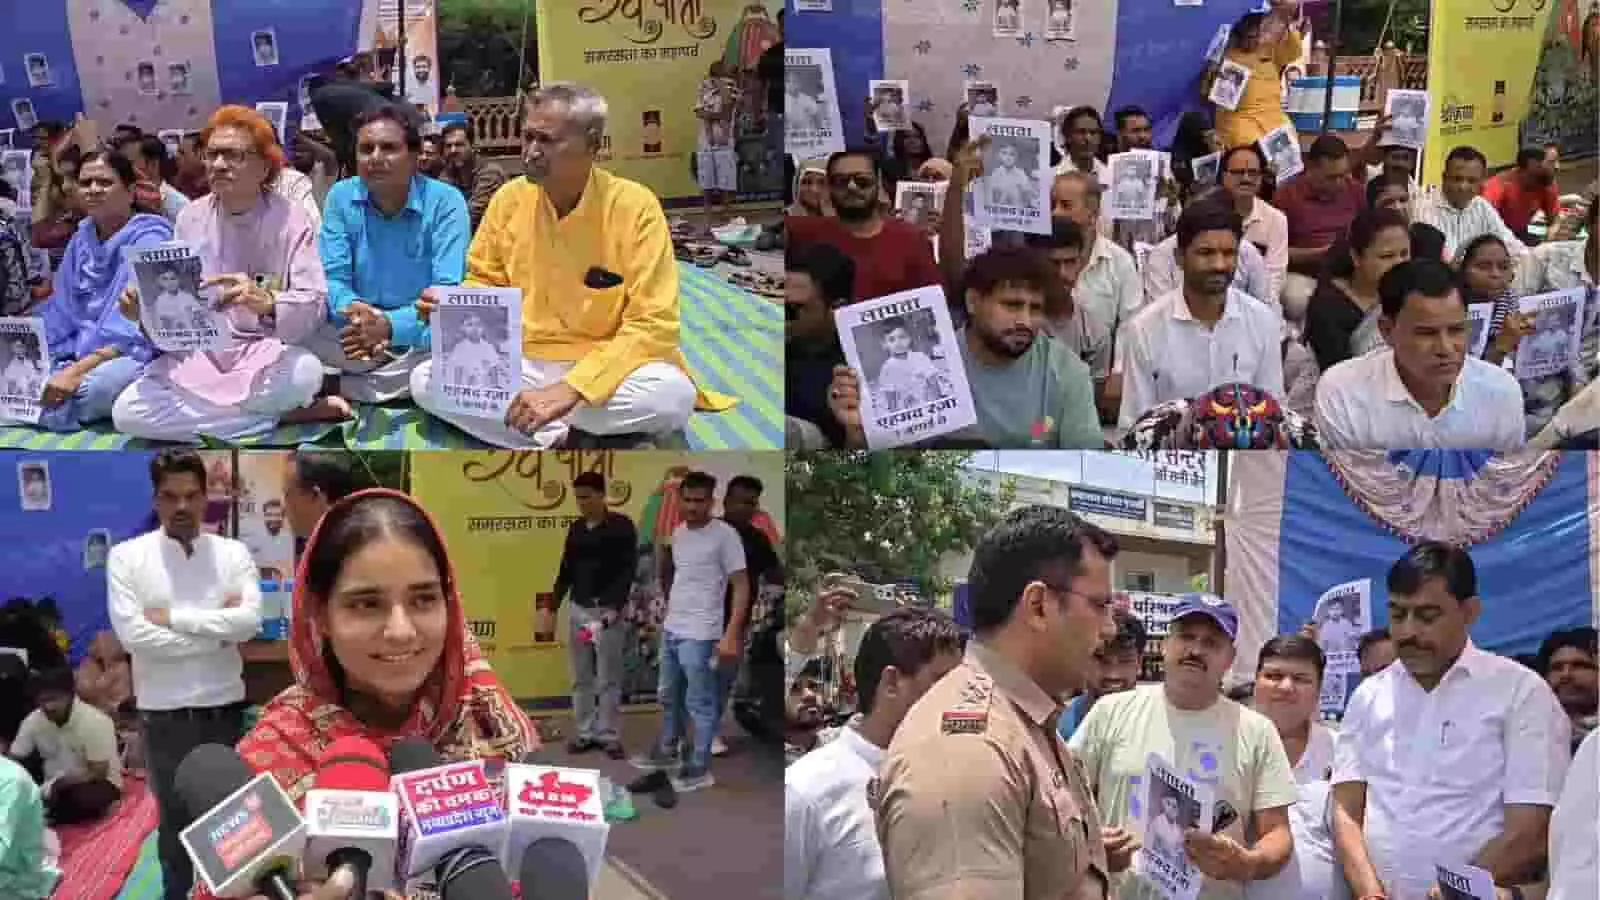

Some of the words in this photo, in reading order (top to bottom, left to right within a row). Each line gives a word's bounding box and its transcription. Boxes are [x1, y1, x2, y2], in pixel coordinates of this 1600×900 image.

[447, 293, 499, 305] लापता
[861, 297, 921, 322] लापता
[415, 770, 478, 796] दर्पण
